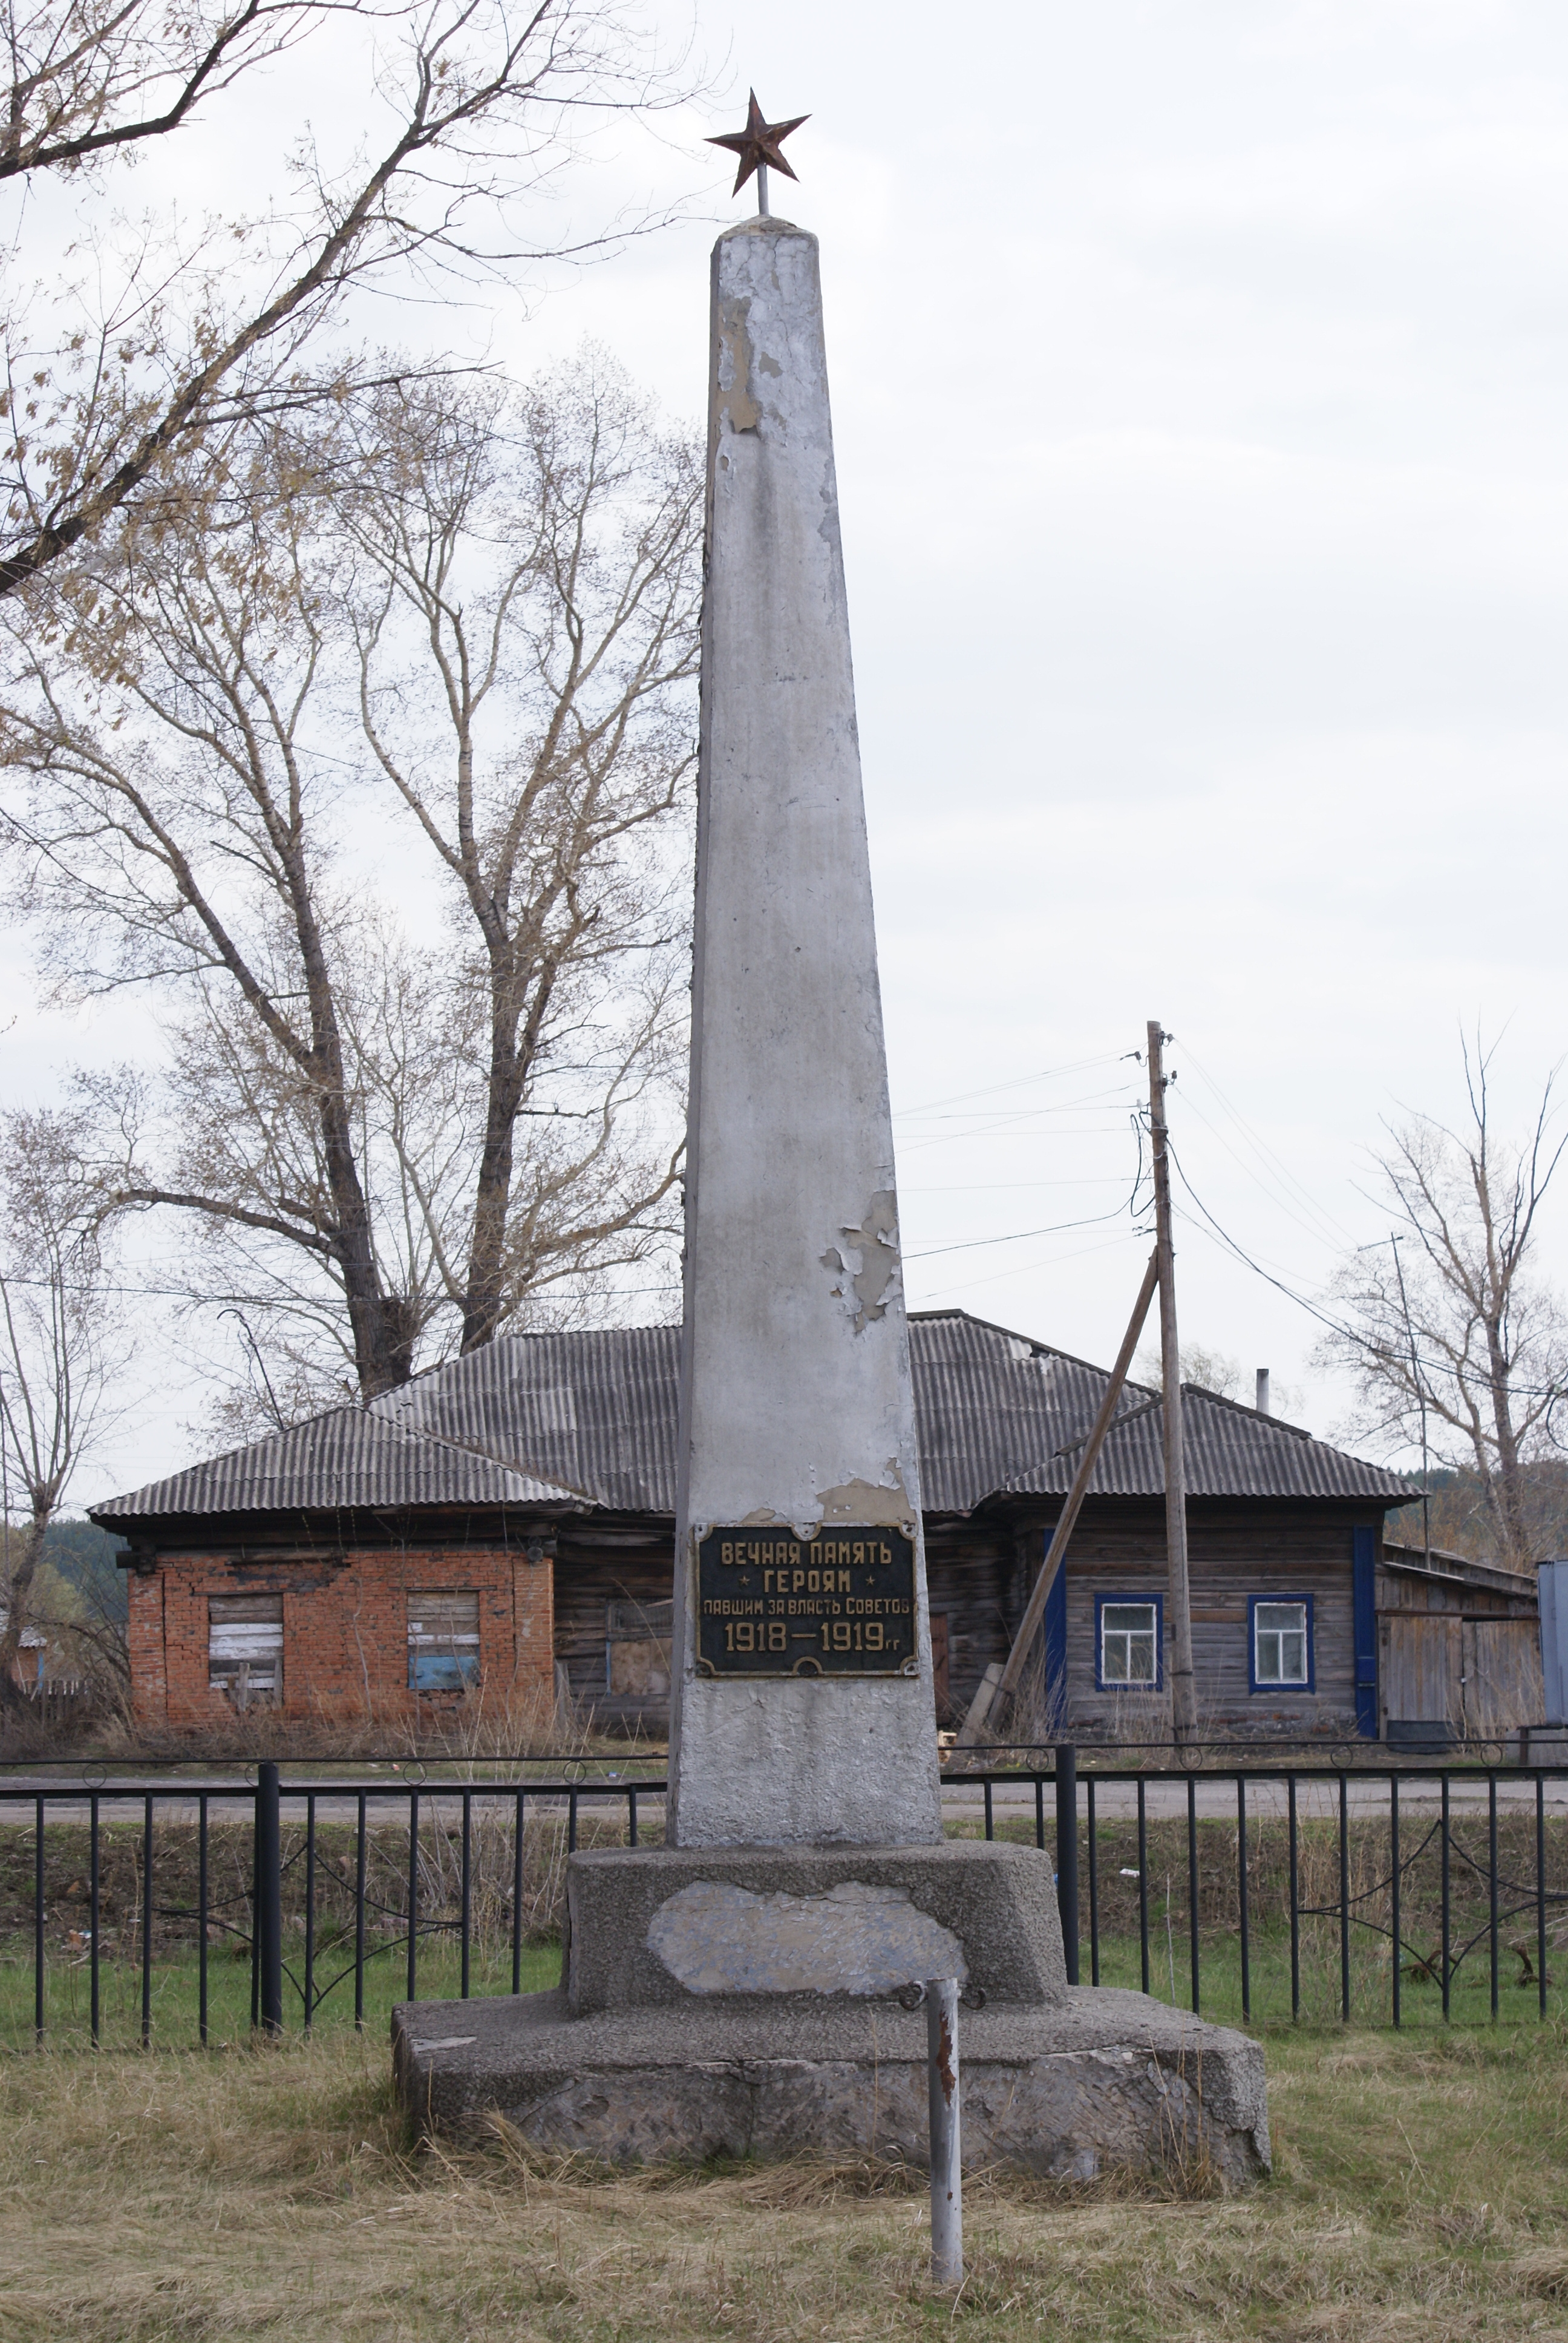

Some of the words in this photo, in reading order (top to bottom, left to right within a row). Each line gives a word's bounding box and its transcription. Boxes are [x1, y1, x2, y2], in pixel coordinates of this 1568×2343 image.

[721, 1542, 802, 1565] ВЕЧНАЯ
[810, 1542, 892, 1564] ПАМЯТЬ
[763, 1570, 851, 1593] ГЕРОЯМ
[704, 1600, 763, 1615] ПАВШИМ
[768, 1600, 785, 1615] ЗА
[788, 1599, 841, 1615] ВЛАСТЬ
